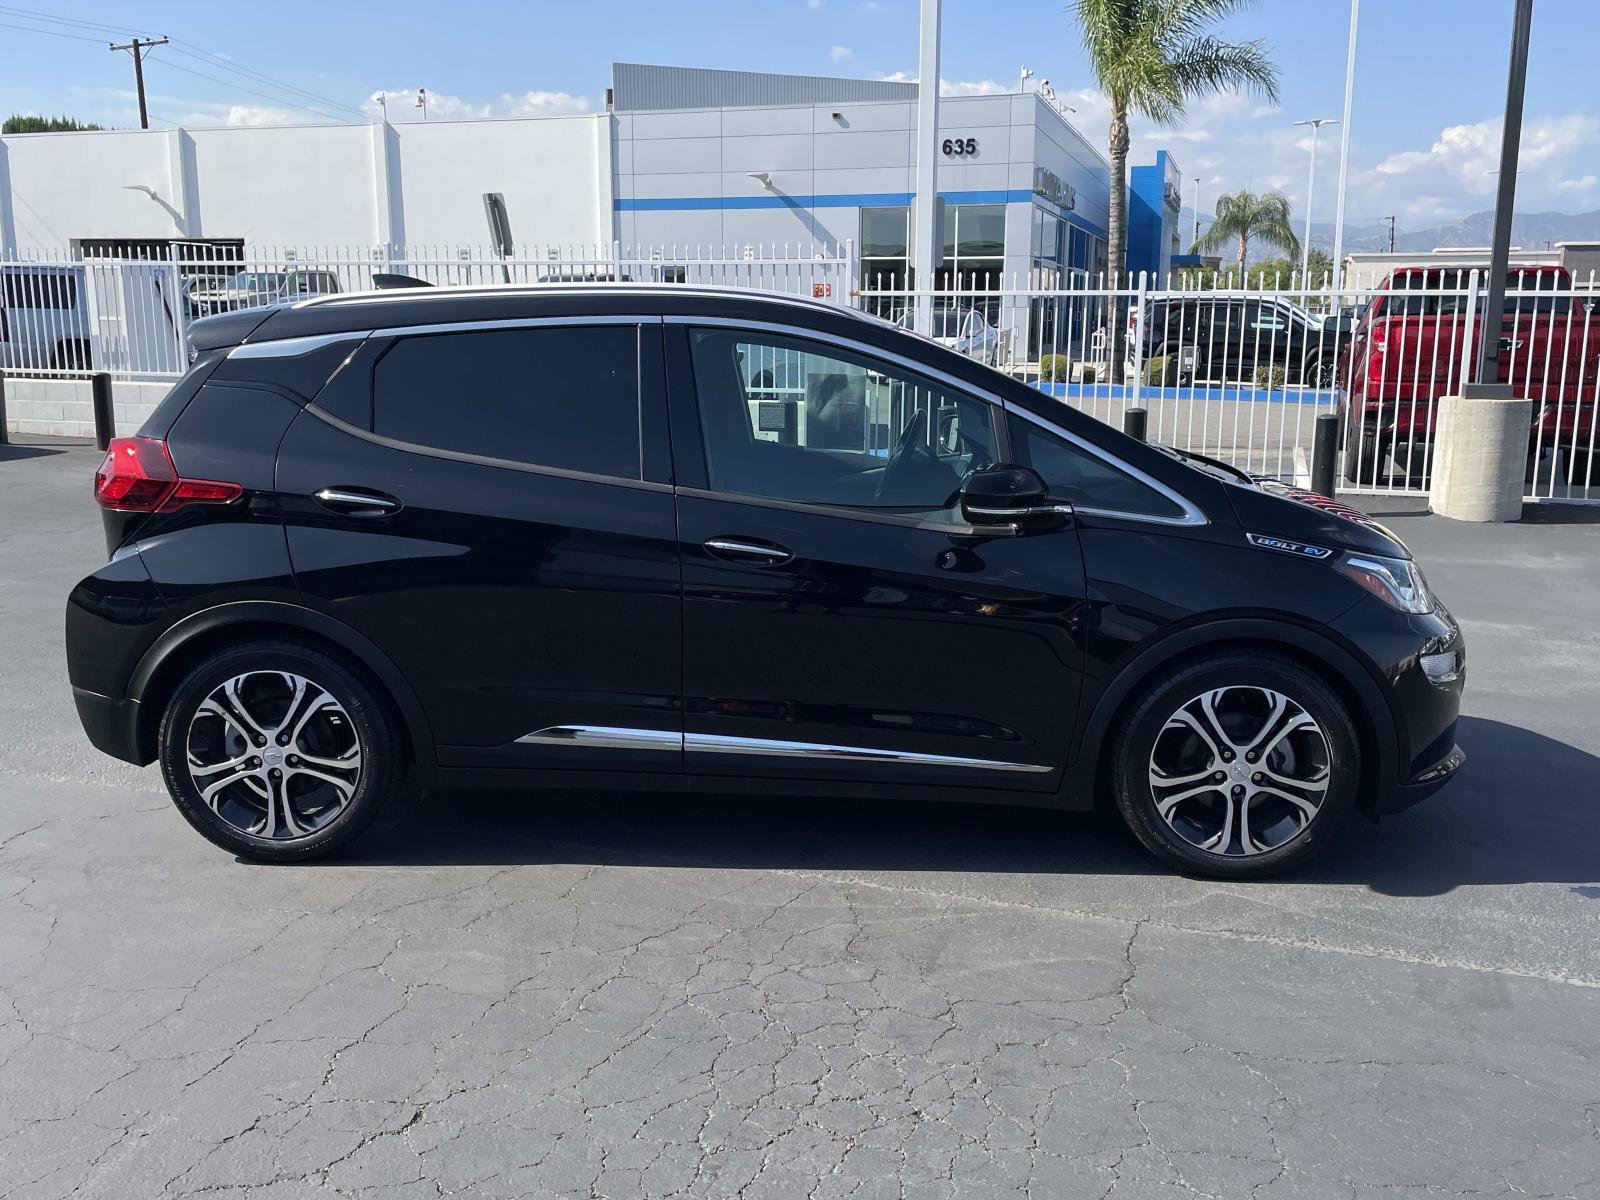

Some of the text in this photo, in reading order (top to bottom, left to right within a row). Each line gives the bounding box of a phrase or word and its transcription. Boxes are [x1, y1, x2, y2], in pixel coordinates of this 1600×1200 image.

[942, 138, 976, 156] 635
[1257, 537, 1325, 556] BOLT EV
